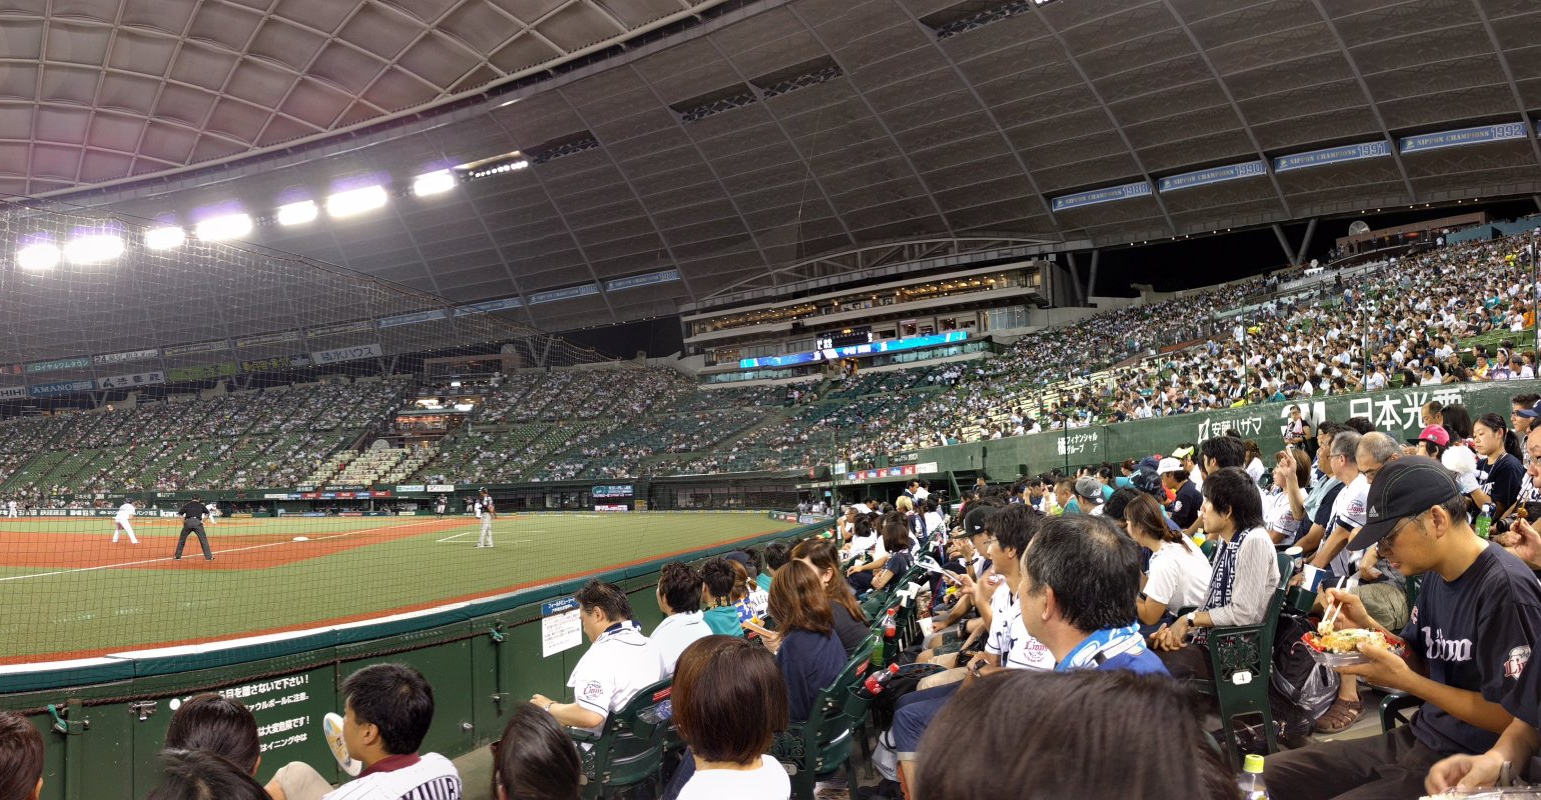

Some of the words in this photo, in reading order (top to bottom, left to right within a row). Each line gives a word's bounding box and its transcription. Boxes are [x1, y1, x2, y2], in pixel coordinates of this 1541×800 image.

[1417, 136, 1444, 146] NIPPON
[1446, 130, 1490, 141] CHAMPIONS
[1490, 125, 1522, 139] 1992
[1289, 155, 1315, 165] NIPPON
[1316, 149, 1356, 161] CHAMPIONS
[1357, 141, 1386, 156] 1991
[1173, 176, 1196, 185] NIPPON
[1197, 169, 1234, 181] CHAMPIONS
[1235, 163, 1262, 177] 1990
[1065, 195, 1087, 204] NIPPON
[1088, 190, 1122, 201] CHAMPIONS
[1122, 184, 1147, 197] 1988
[32, 383, 73, 394] AMANO
